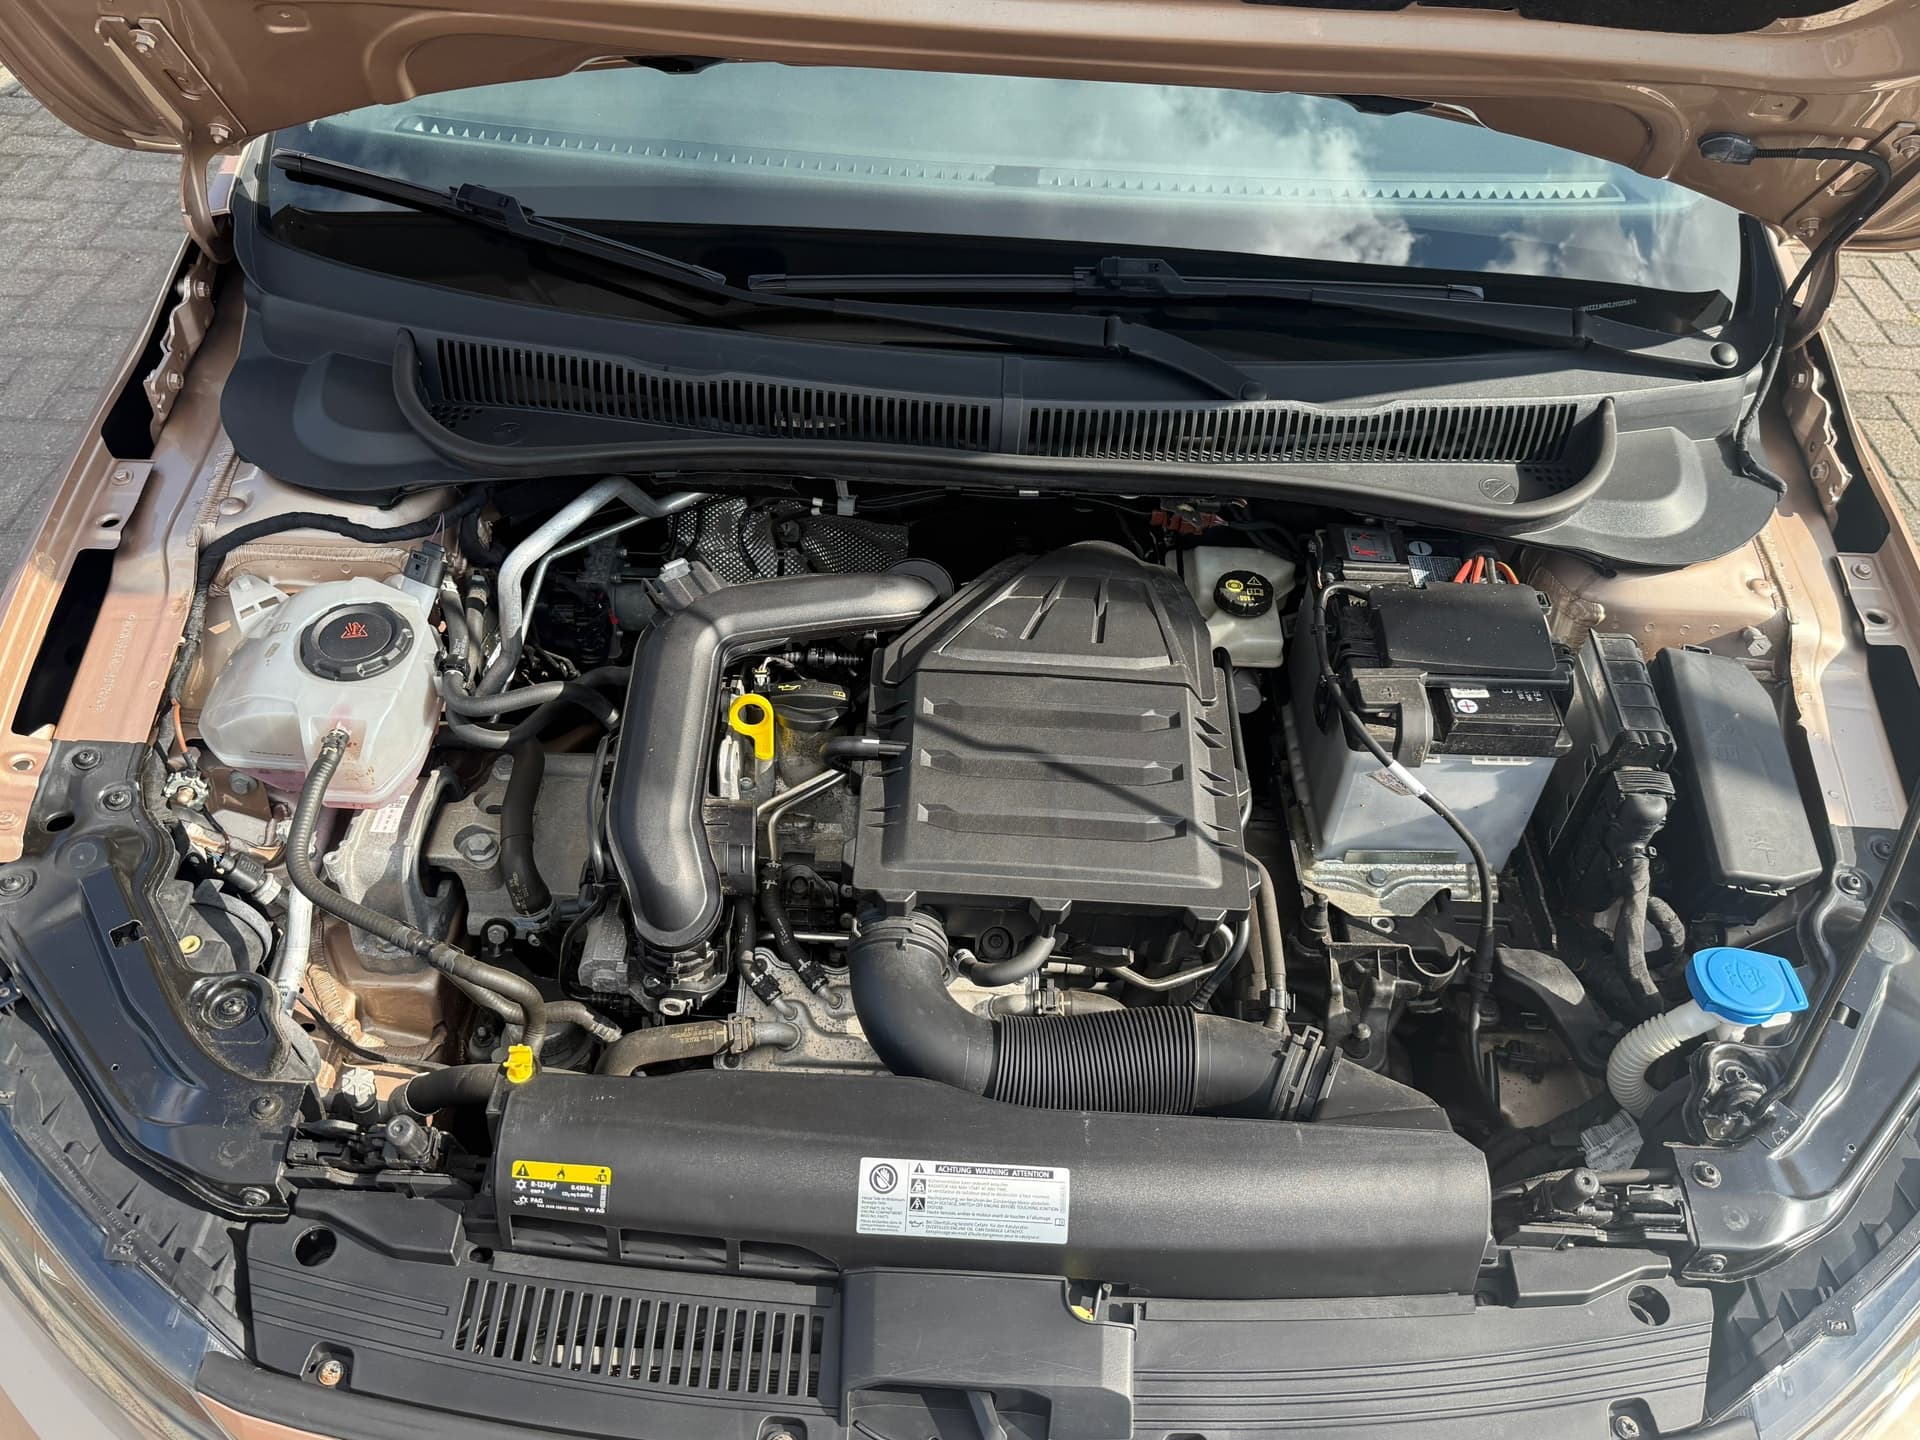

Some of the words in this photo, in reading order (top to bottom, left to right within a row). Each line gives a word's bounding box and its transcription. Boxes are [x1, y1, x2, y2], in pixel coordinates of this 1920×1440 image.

[937, 1164, 972, 1174] ACHTUNG
[975, 1167, 1009, 1176] WARNING
[1011, 1169, 1050, 1178] ATTENTION
[530, 1180, 557, 1190] R-1234yf
